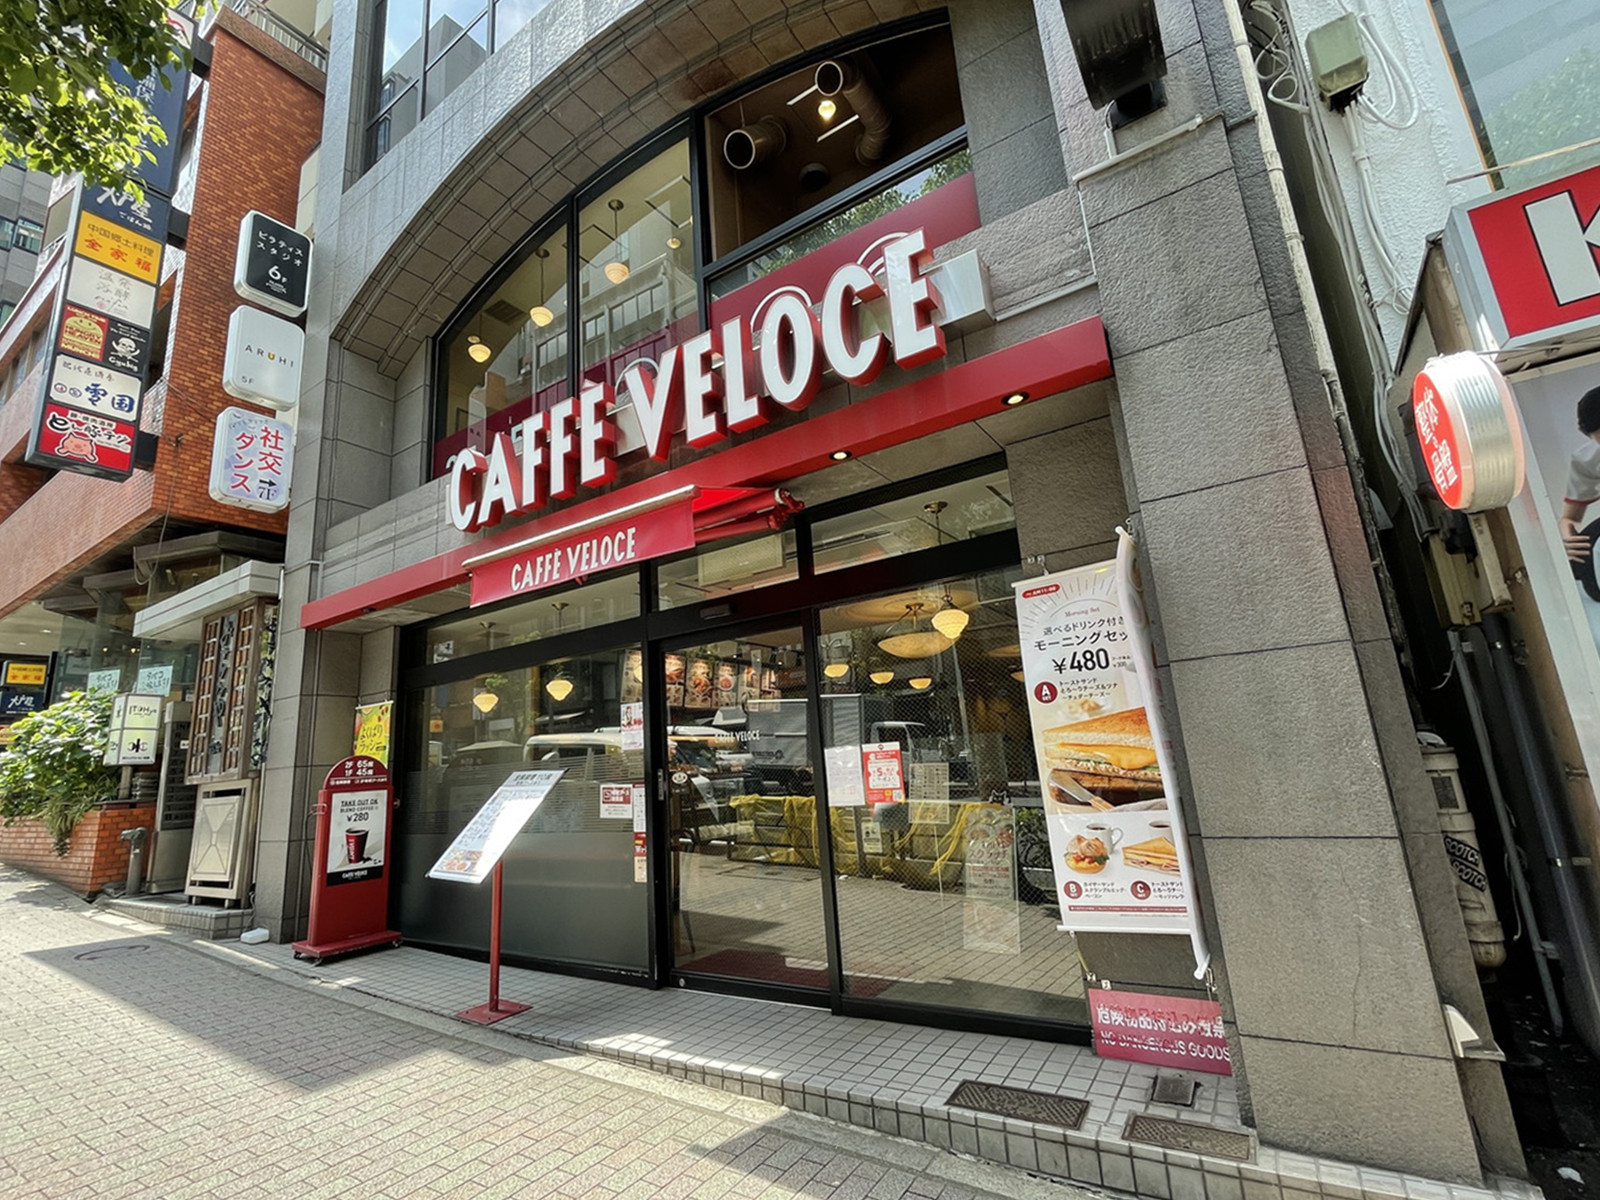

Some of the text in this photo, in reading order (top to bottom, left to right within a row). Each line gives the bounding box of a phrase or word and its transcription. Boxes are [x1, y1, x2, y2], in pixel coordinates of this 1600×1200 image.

[245, 344, 295, 368] ARUHI
[241, 376, 255, 385] 5F
[450, 228, 944, 531] CAFFÈ VELOCE
[230, 432, 258, 493] ダンス
[257, 426, 285, 476] 社交
[511, 526, 637, 592] CAFFÈ VELOCE
[1052, 648, 1110, 674] ¥480
[1041, 684, 1051, 697] A
[735, 730, 760, 742] VELOCE
[1069, 883, 1077, 893] B
[1136, 883, 1145, 894] C
